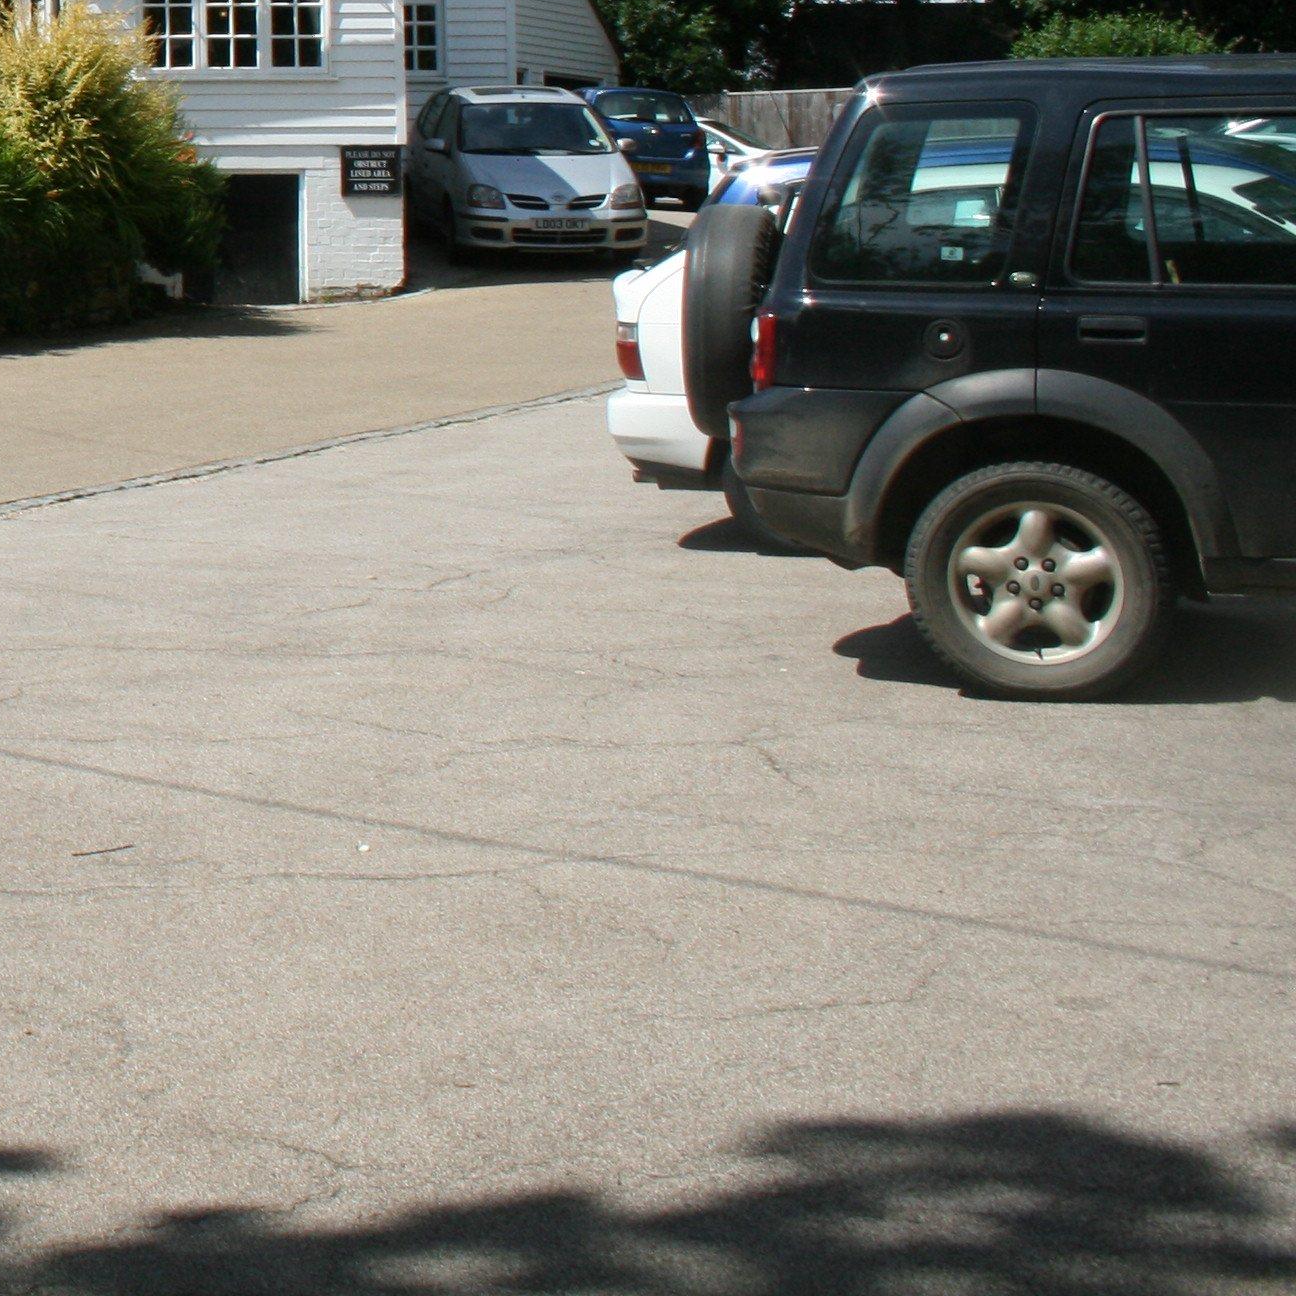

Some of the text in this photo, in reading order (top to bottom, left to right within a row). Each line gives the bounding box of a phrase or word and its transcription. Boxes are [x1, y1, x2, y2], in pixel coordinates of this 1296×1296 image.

[345, 150, 396, 159] PLEASE DO NOT
[353, 160, 387, 168] OBSTRUCT
[373, 169, 392, 178] AREA
[353, 183, 368, 191] AND
